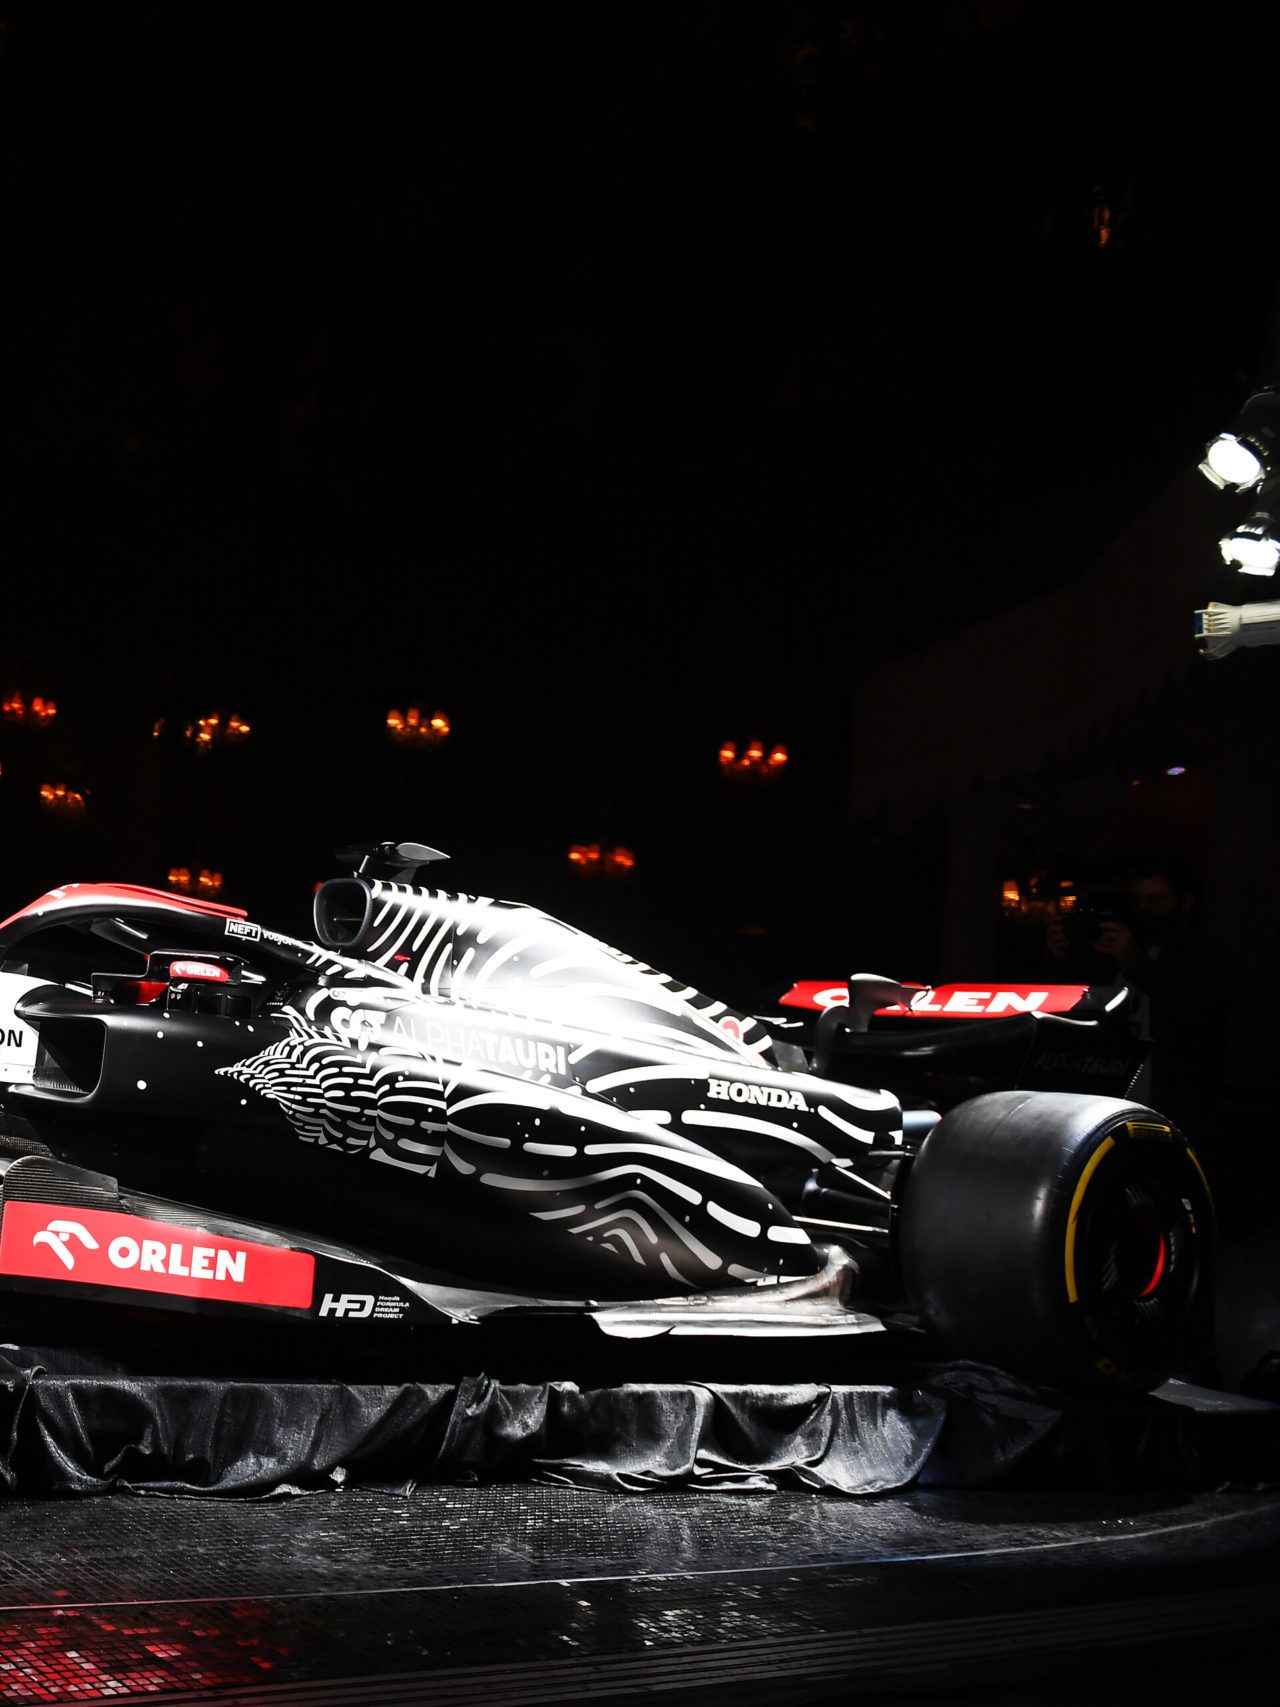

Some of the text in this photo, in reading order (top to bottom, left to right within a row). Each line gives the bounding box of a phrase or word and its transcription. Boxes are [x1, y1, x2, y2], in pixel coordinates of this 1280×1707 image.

[228, 921, 258, 937] NEFT
[813, 986, 1049, 1013] OLEN
[706, 1078, 810, 1112] HONDA
[107, 1235, 247, 1283] ORLEN
